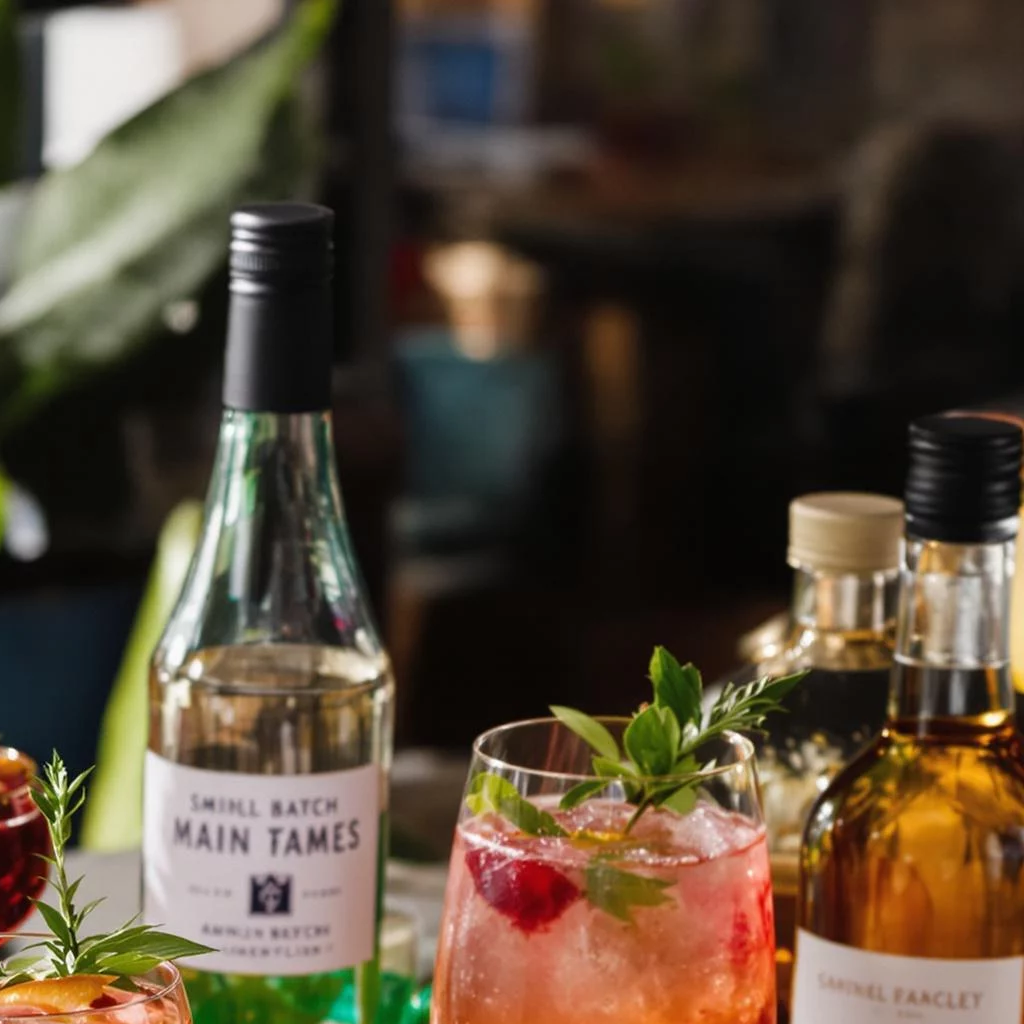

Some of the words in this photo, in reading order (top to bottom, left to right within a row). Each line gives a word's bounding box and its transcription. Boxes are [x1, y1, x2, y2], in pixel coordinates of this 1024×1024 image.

[271, 797, 338, 818] BATCH
[173, 818, 250, 855] MAIN
[268, 819, 361, 856] TAMES
